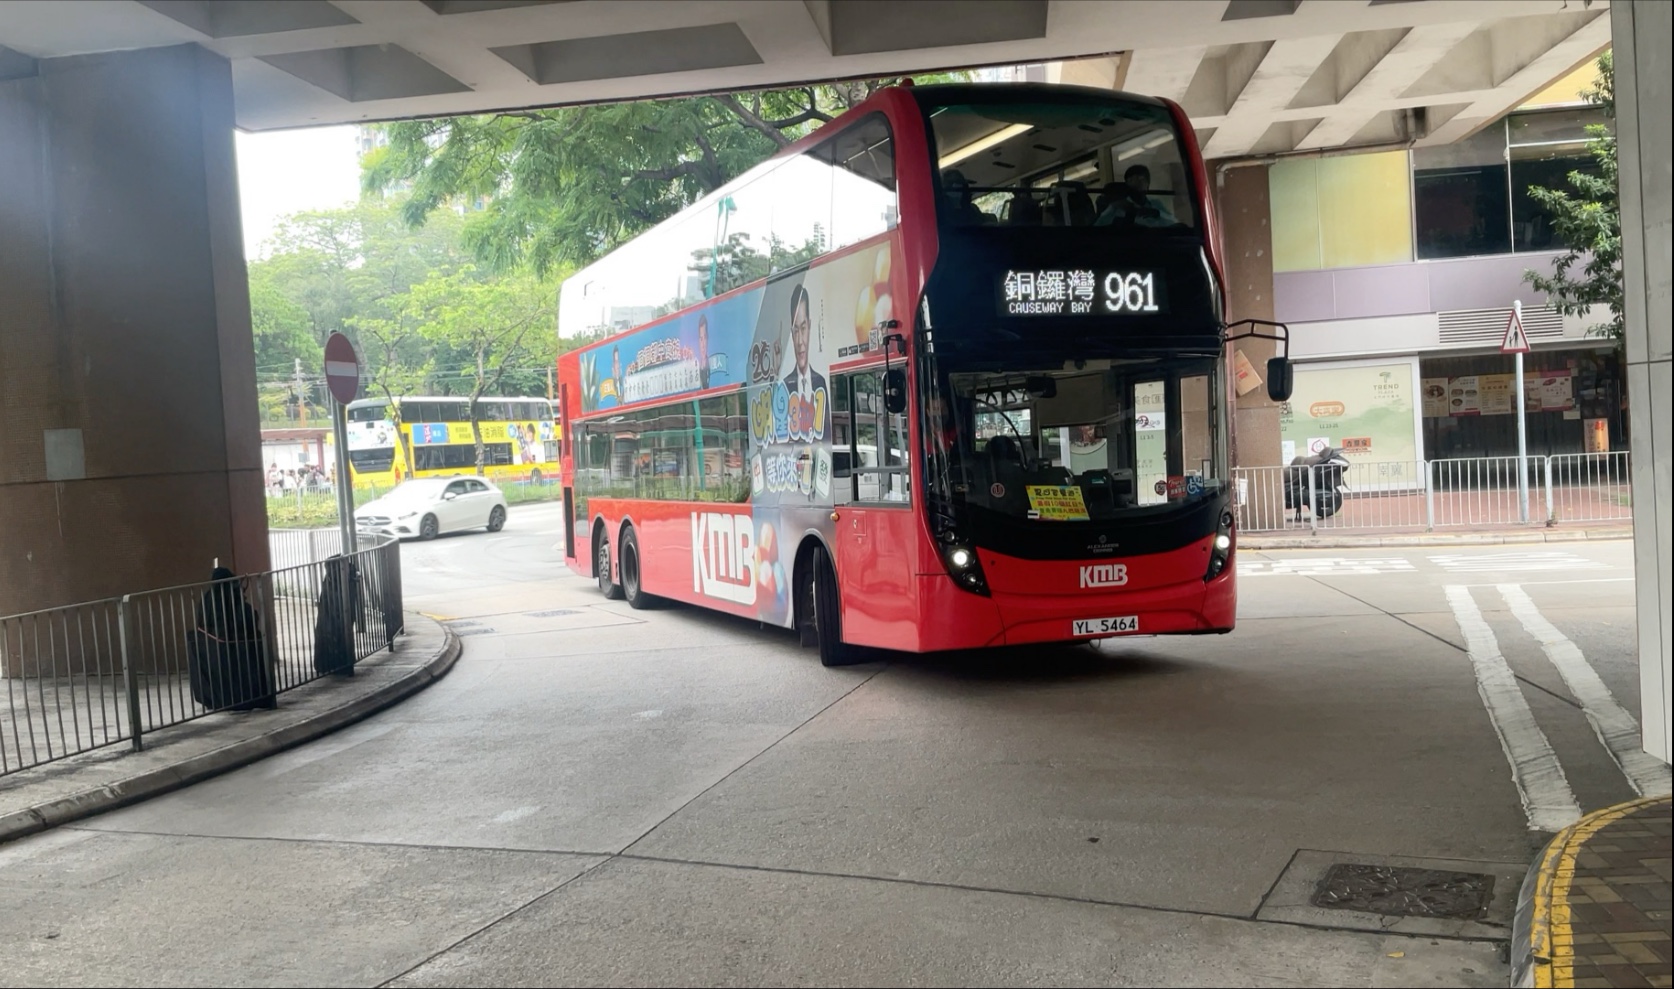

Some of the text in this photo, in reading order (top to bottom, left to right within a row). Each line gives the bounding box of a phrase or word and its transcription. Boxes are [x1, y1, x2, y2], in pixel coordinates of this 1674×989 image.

[1004, 270, 1095, 301] 銅鑼灣
[1104, 272, 1159, 311] 961
[1009, 302, 1093, 314] CAUSEWAY BAY
[1373, 383, 1400, 391] TREND
[691, 511, 757, 606] KMB
[1079, 564, 1129, 588] KMB
[1075, 617, 1136, 634] YL 5464
